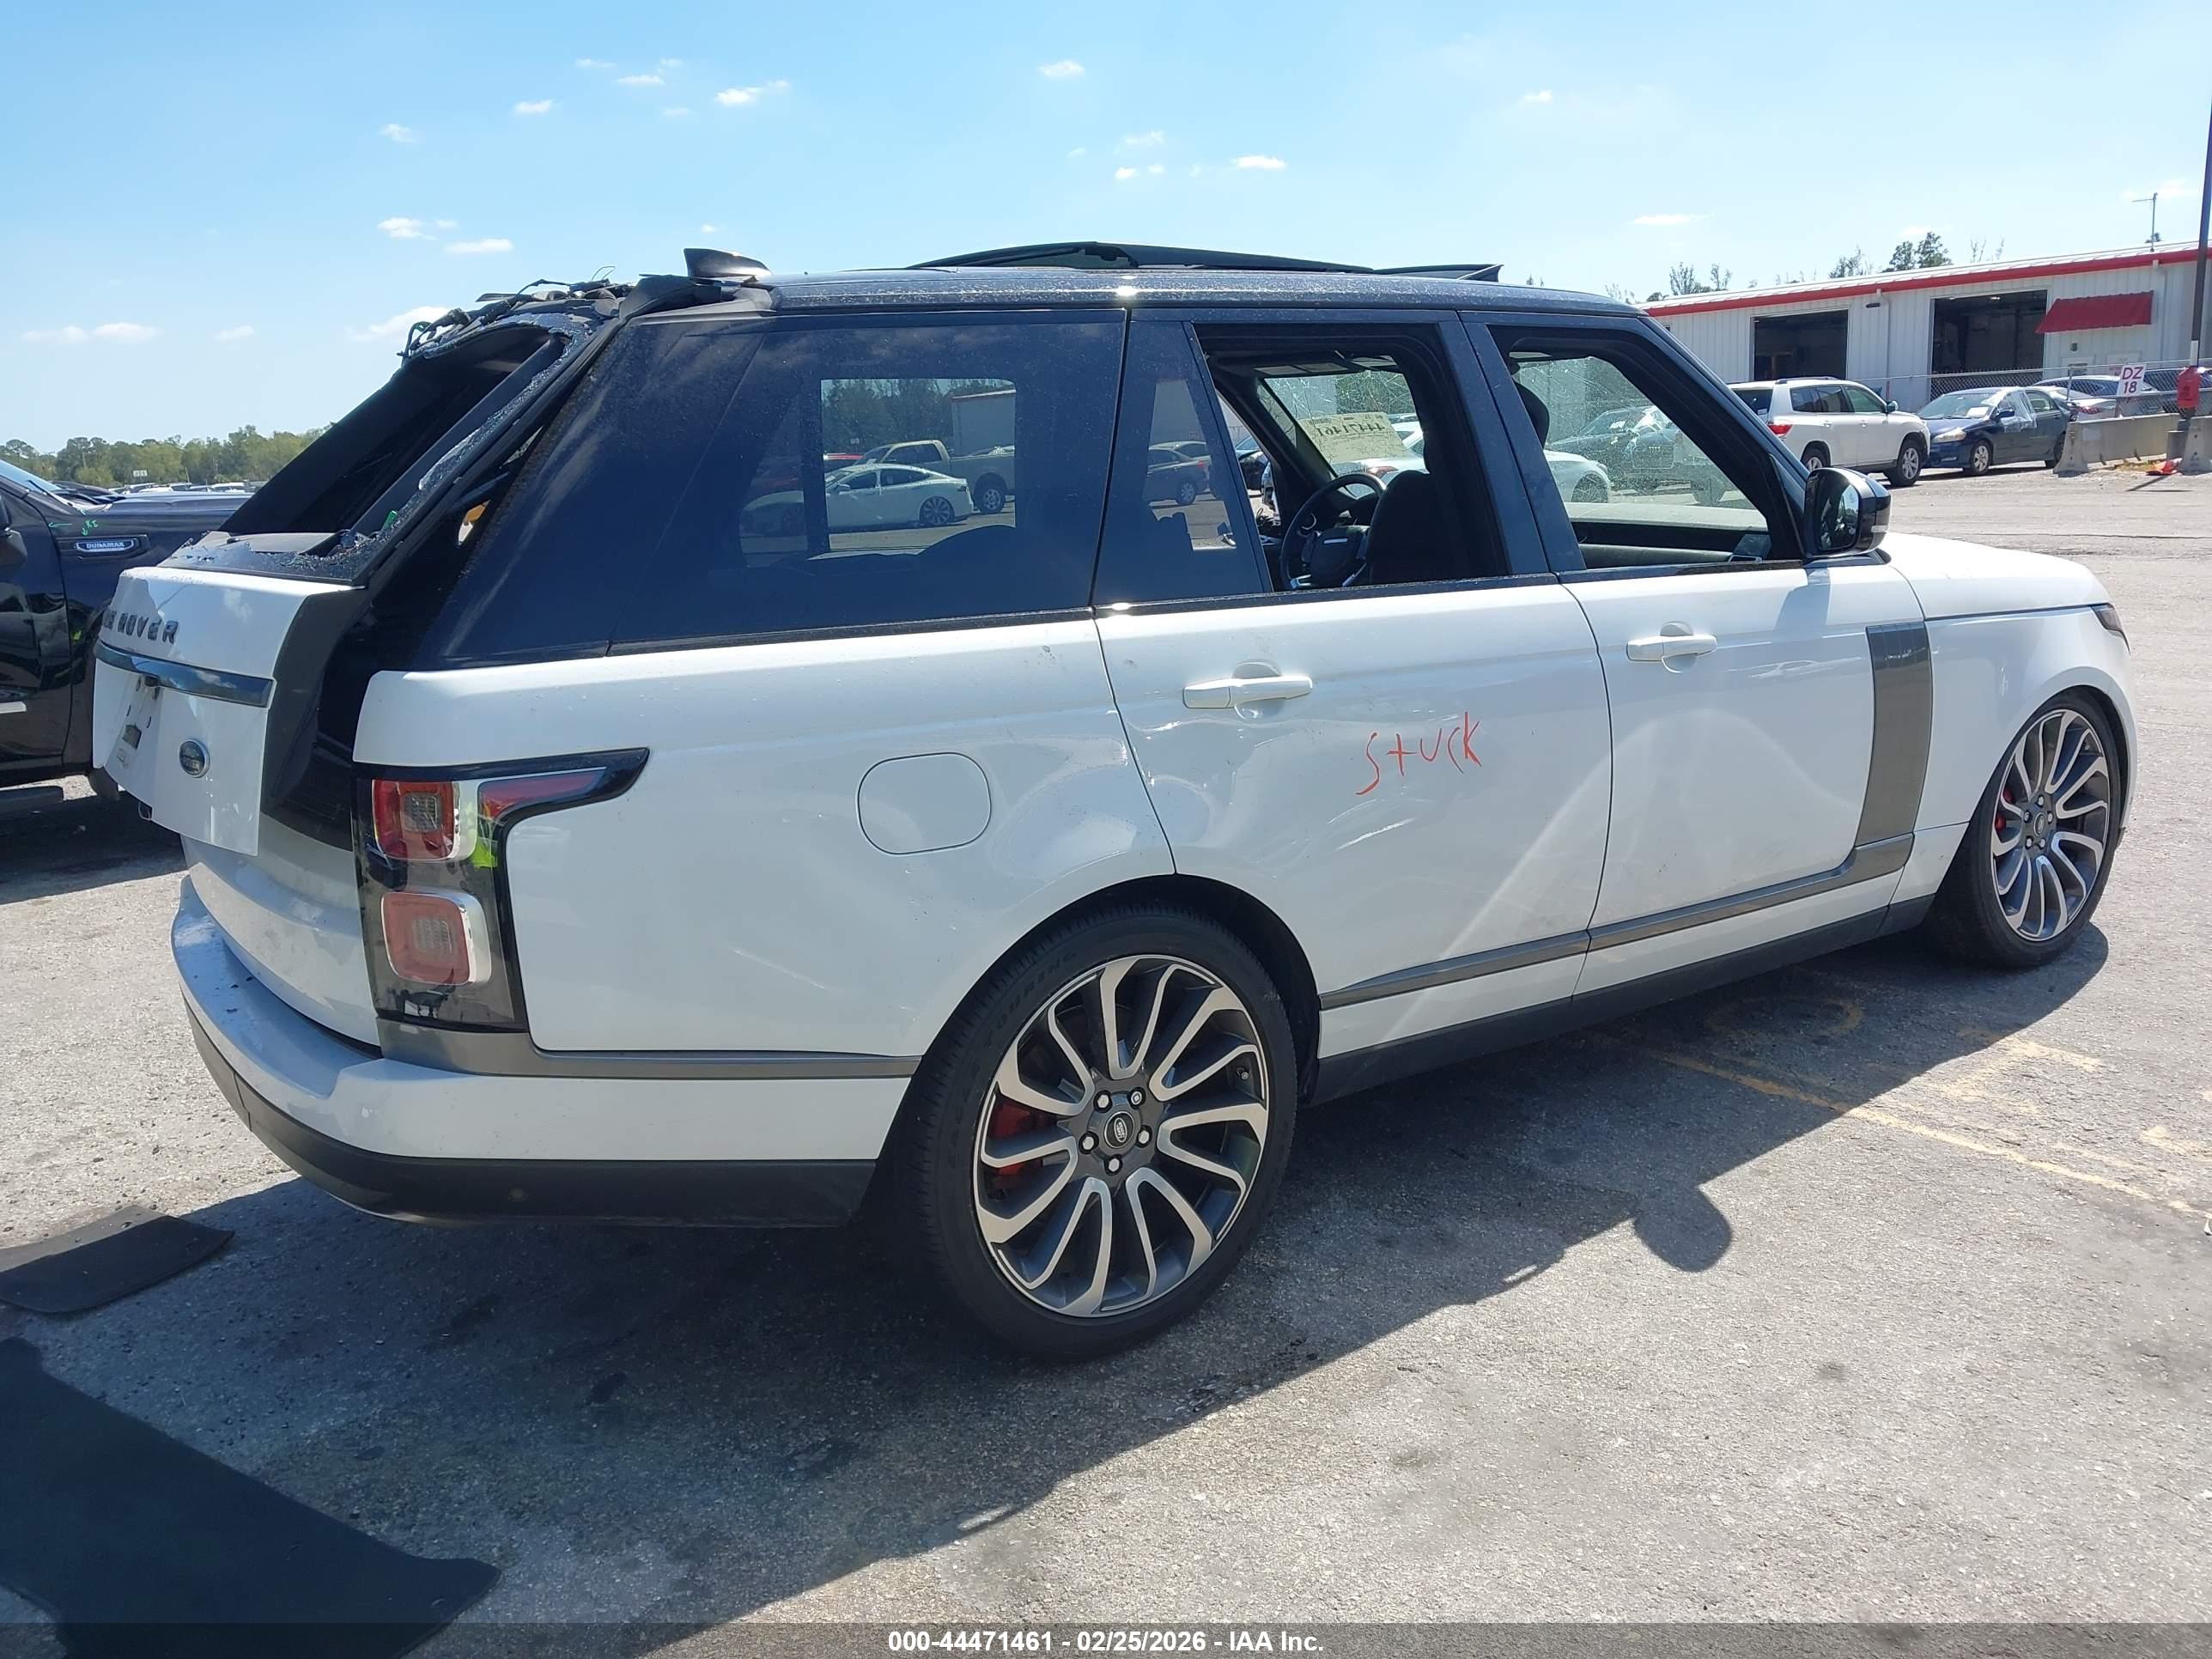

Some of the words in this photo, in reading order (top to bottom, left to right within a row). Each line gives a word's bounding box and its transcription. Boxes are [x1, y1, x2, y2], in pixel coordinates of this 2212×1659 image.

[2122, 366, 2144, 380] DZ
[2124, 380, 2137, 394] 18
[118, 612, 179, 645] ROVER
